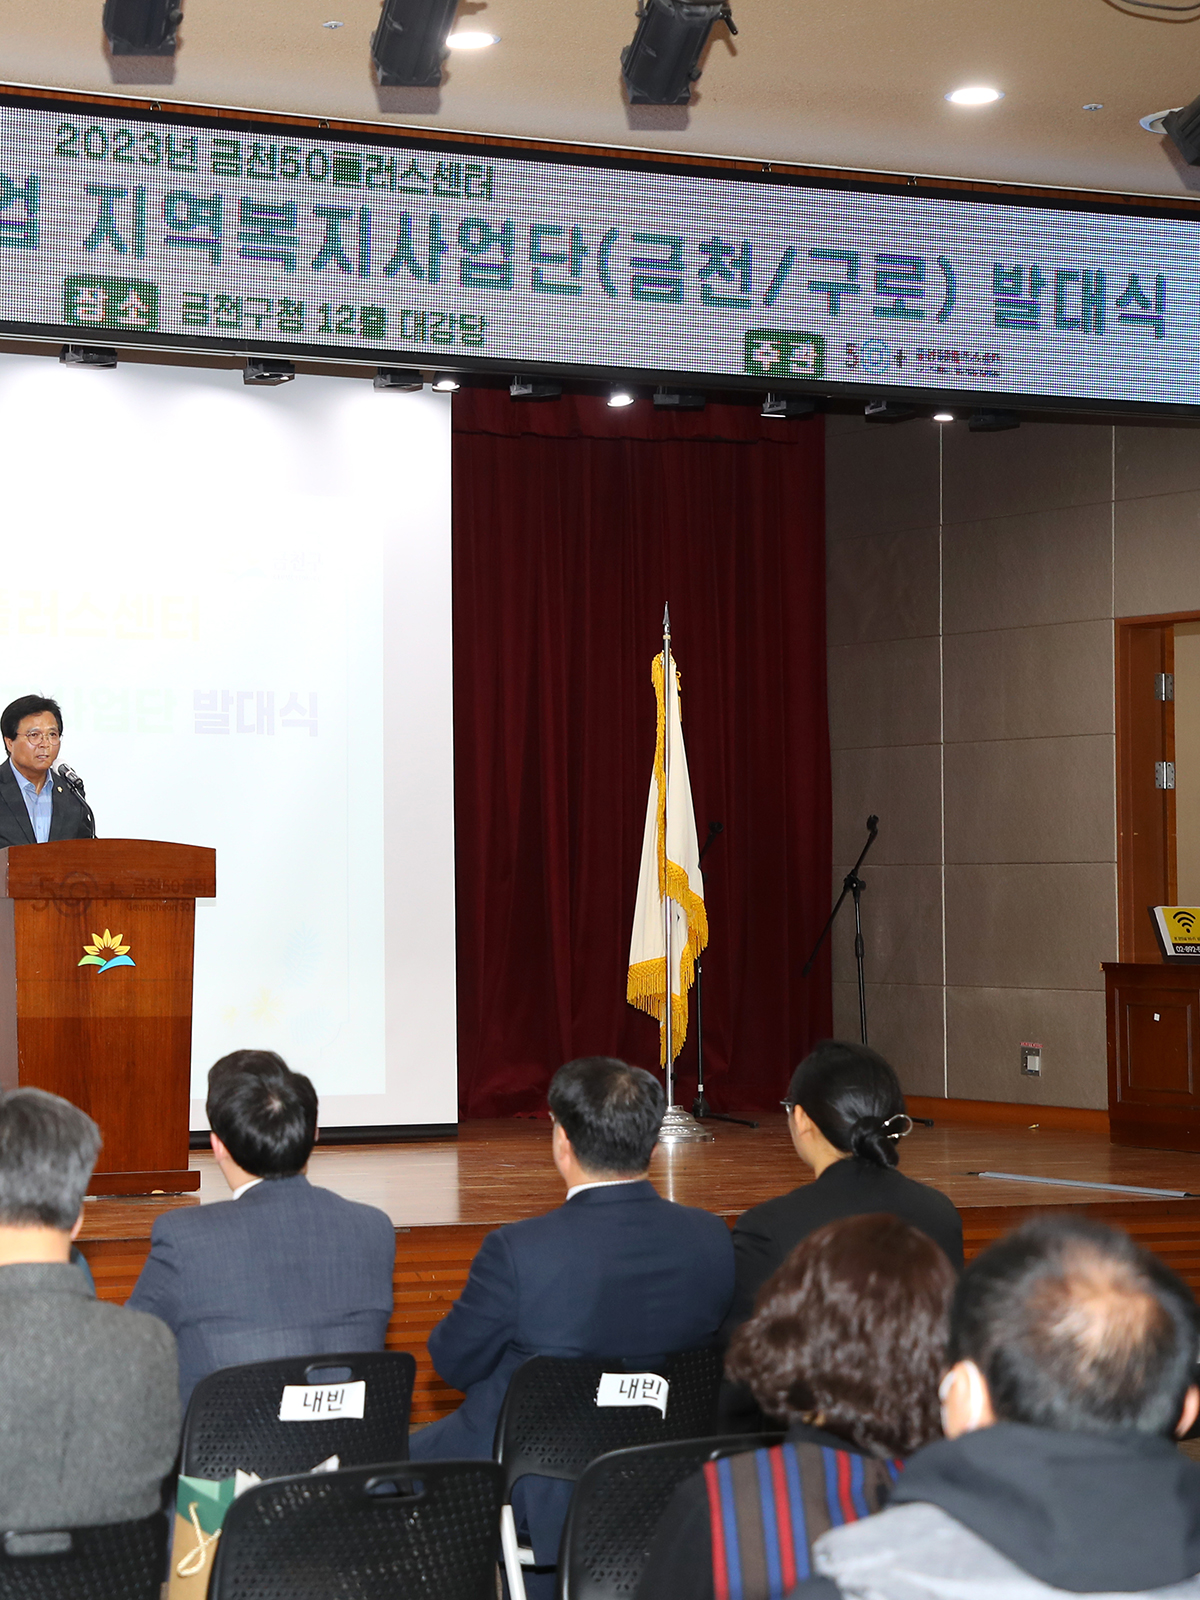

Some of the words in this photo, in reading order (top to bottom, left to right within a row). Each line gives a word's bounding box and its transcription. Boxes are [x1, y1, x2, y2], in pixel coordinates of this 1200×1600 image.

[55, 121, 198, 173] 2023년
[82, 182, 956, 324] 지역복지사업단(금천/구로)
[992, 262, 1168, 340] 발대식
[181, 291, 305, 334] 금천구청
[400, 308, 488, 347] 대강당
[191, 687, 320, 738] 발대식
[303, 1389, 345, 1413] 내빈
[620, 1376, 662, 1401] 내빈
